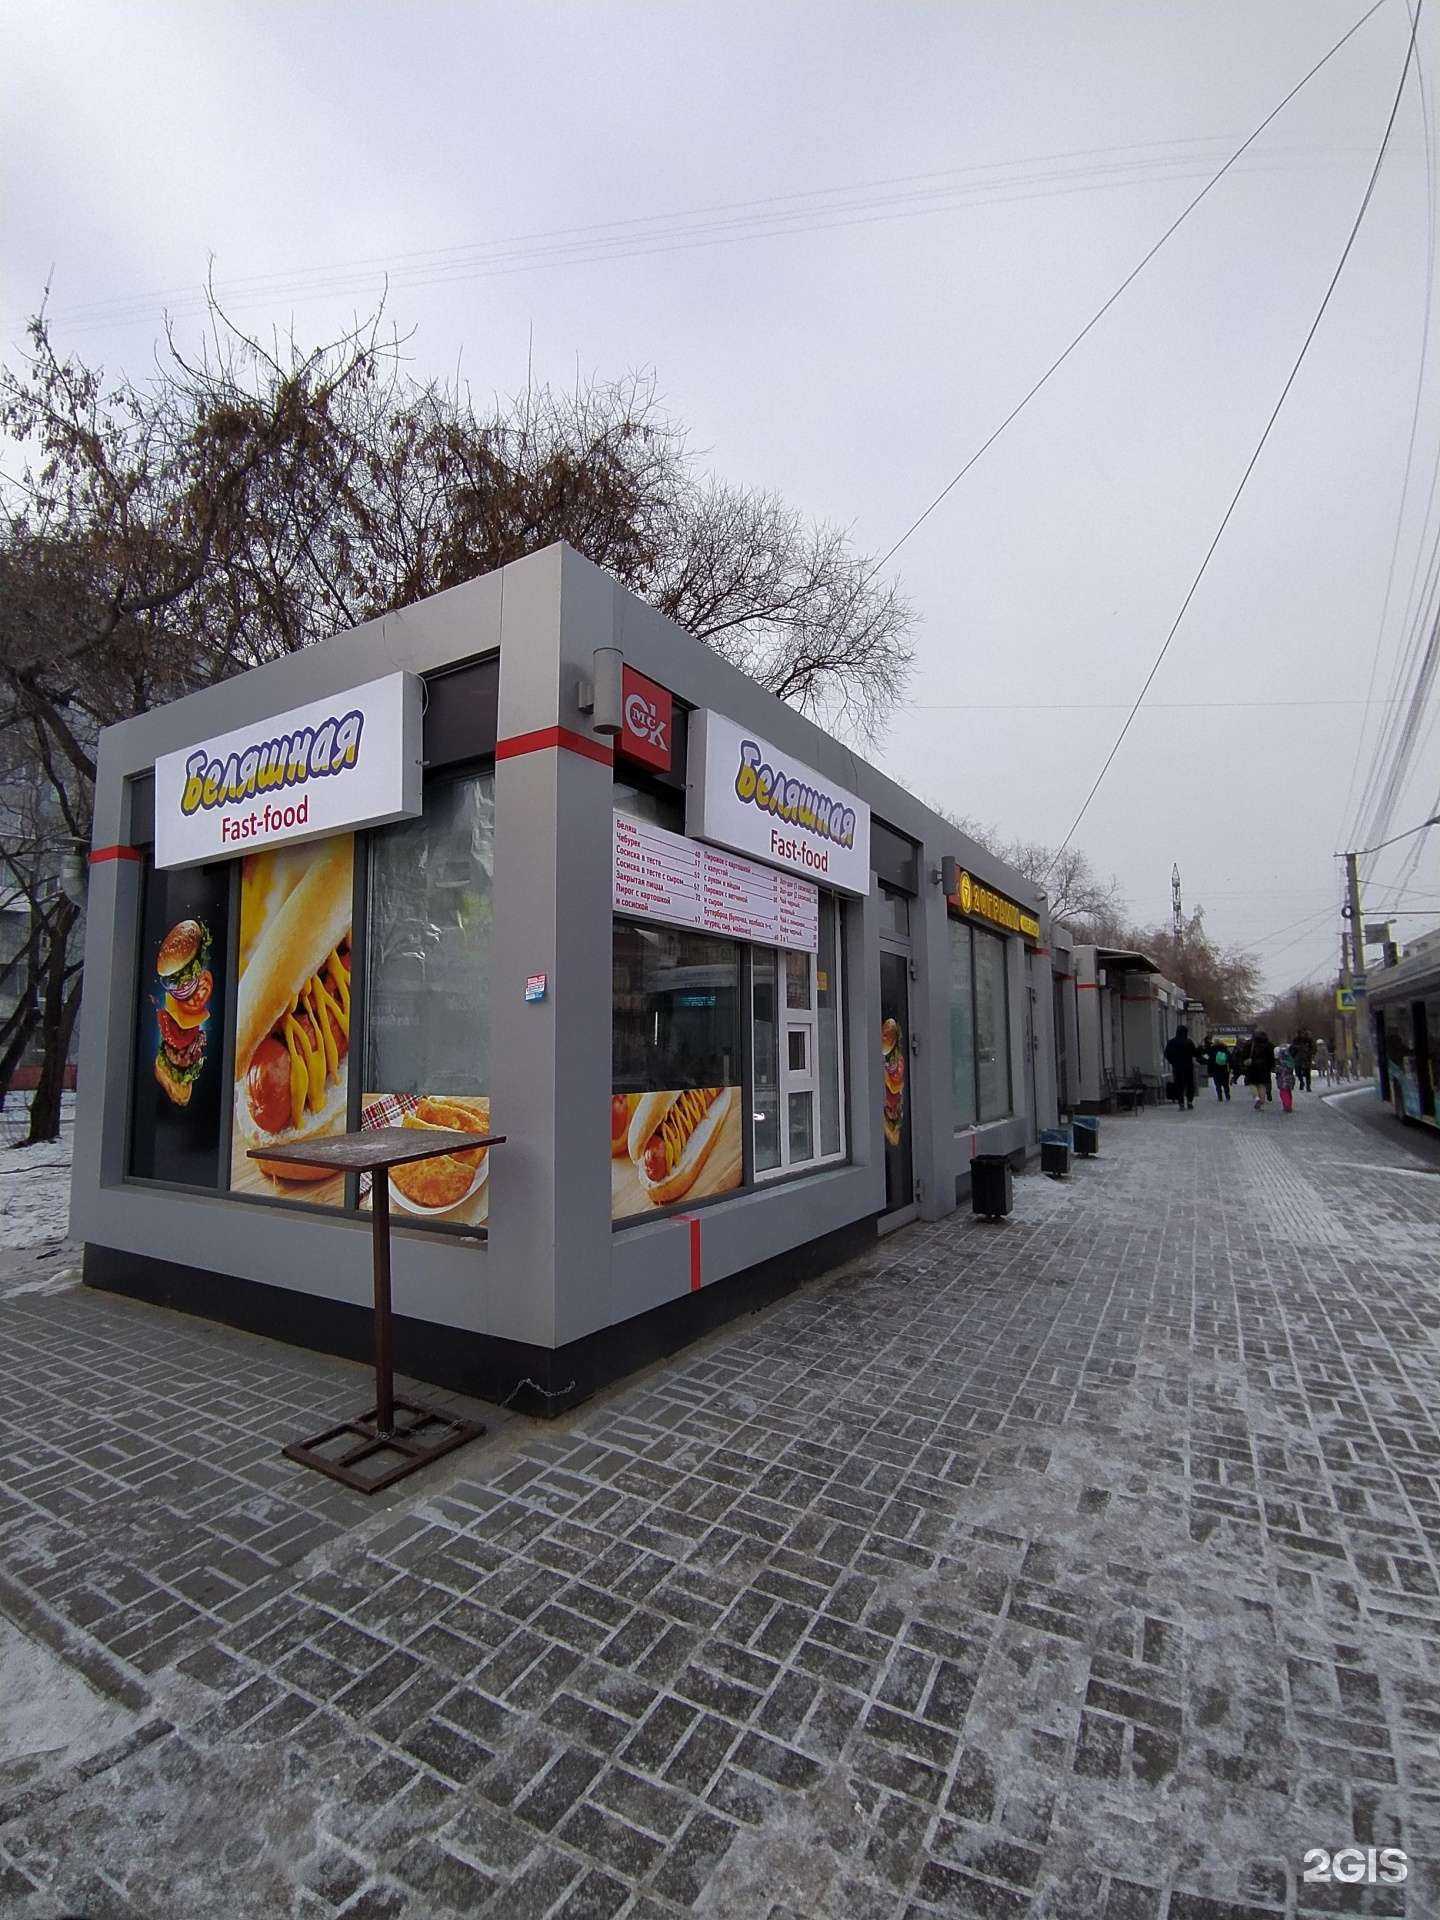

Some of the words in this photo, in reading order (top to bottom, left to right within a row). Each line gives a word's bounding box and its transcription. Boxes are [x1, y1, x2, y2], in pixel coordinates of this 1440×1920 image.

[181, 709, 365, 816] Беляшная
[735, 740, 856, 850] Беляшная
[222, 795, 308, 842] Fast-food
[617, 820, 637, 834] Беляш
[617, 832, 641, 847] Чебурек
[771, 829, 828, 872] Fast-food
[616, 844, 640, 860] Сосиска
[646, 857, 661, 866] тесте
[616, 857, 640, 872] Сосиска
[646, 868, 662, 878] тесте
[666, 875, 683, 885] сыром
[616, 870, 645, 885] Закрытая
[646, 880, 664, 891] пицца
[616, 883, 633, 896] Пирог
[640, 892, 671, 904] картошкой
[621, 899, 649, 911] сосиской
